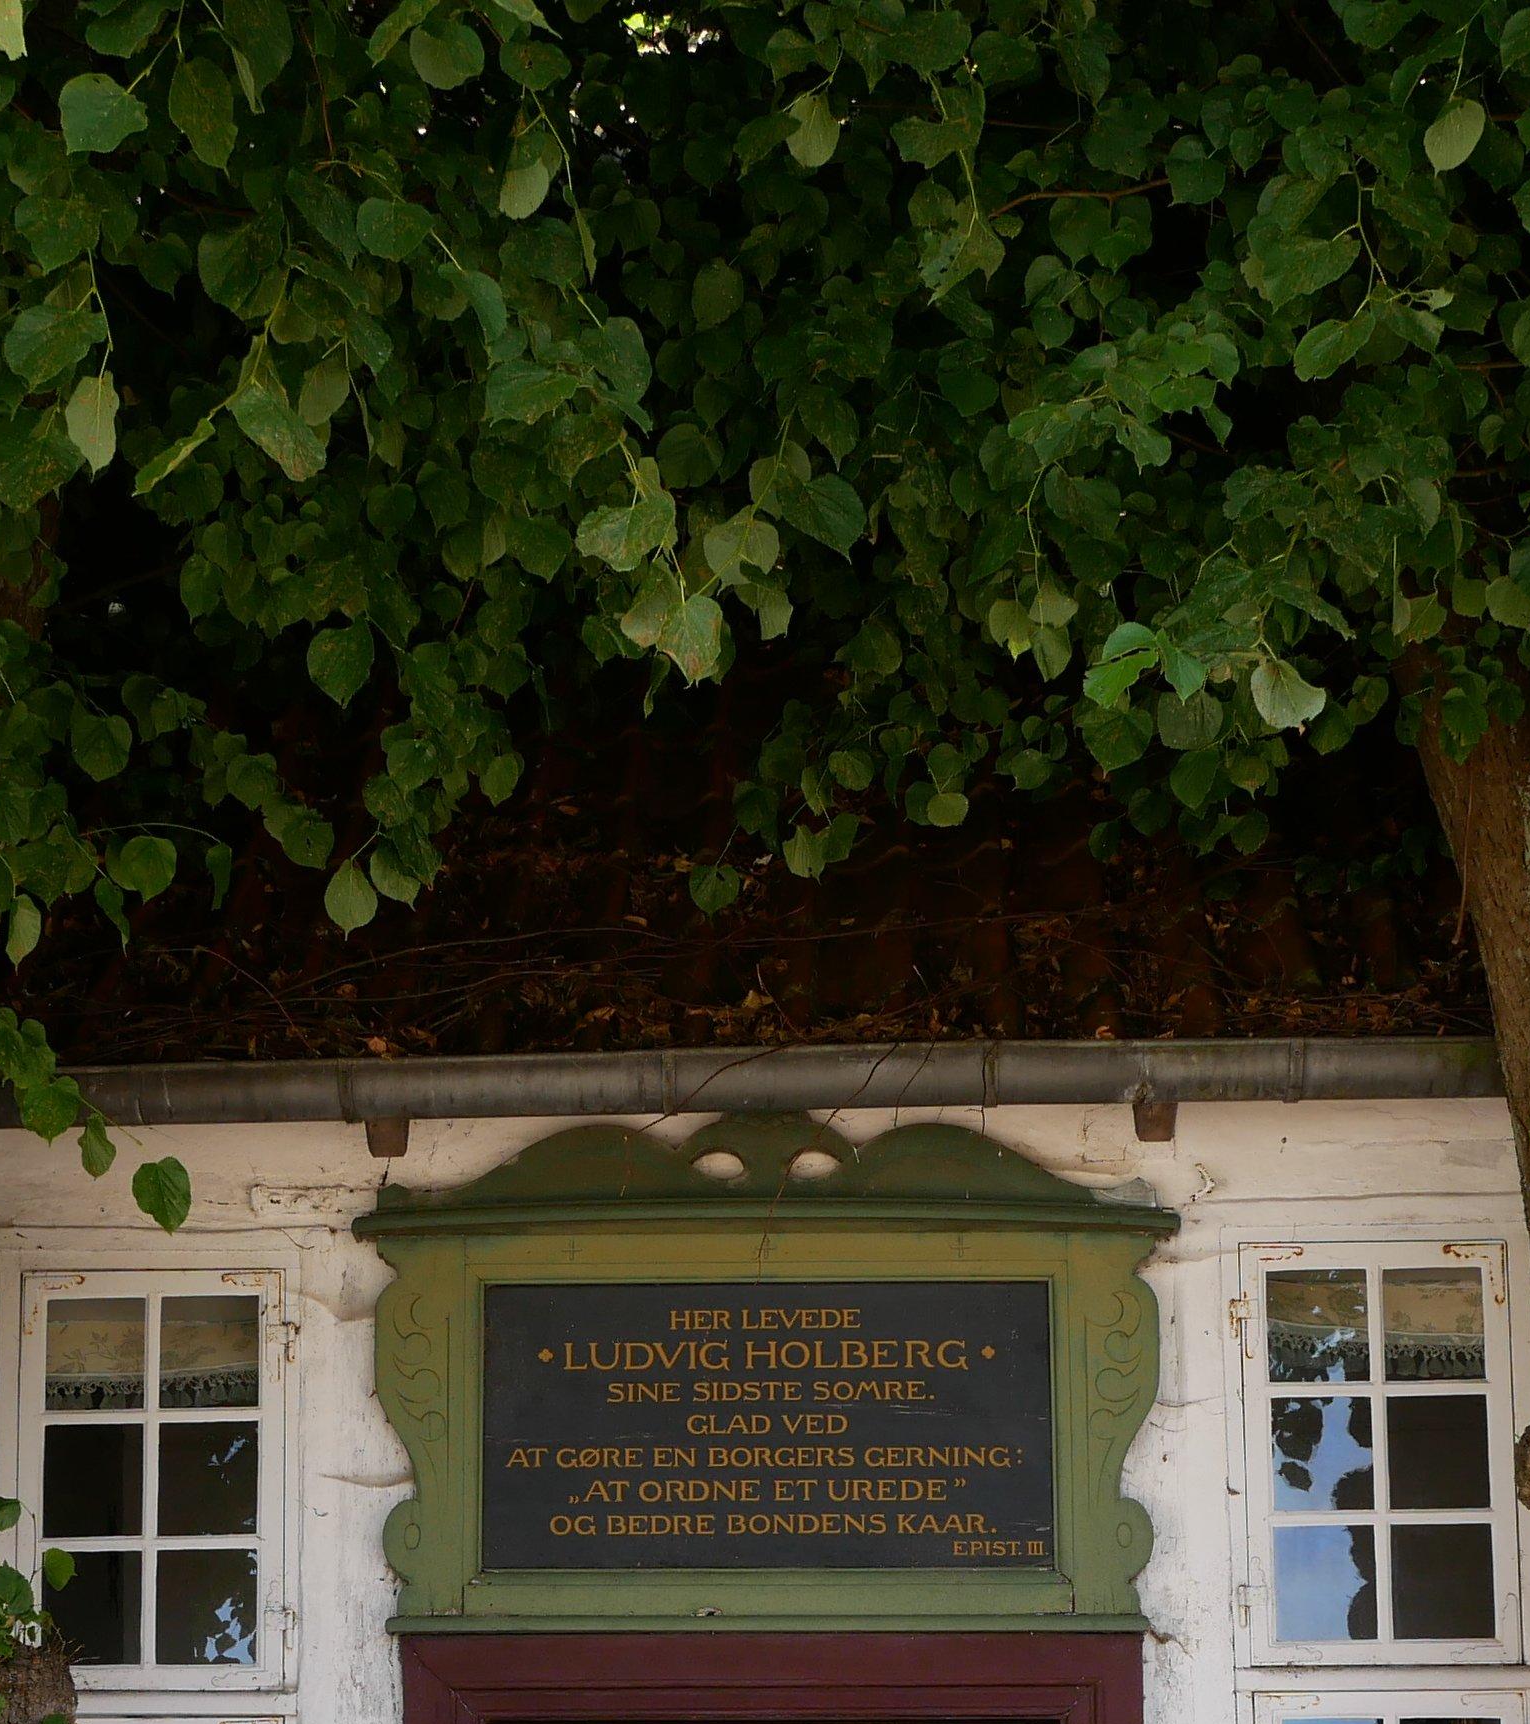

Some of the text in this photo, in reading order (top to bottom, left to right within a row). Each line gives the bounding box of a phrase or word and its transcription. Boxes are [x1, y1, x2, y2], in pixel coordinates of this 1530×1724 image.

[670, 1307, 862, 1331] HER LEVEDE
[565, 1338, 969, 1372] LUDVIG HOLBERG
[608, 1379, 935, 1404] SINE SIDSTE SOMRE.
[686, 1413, 849, 1436] GLAD VED
[507, 1444, 1024, 1469] AT GØRE EN BORGERS GERNING:
[638, 1478, 761, 1504] ORDNE
[773, 1478, 820, 1502] ET
[549, 1512, 997, 1536] OG BEDRE BONDENS KAAR.
